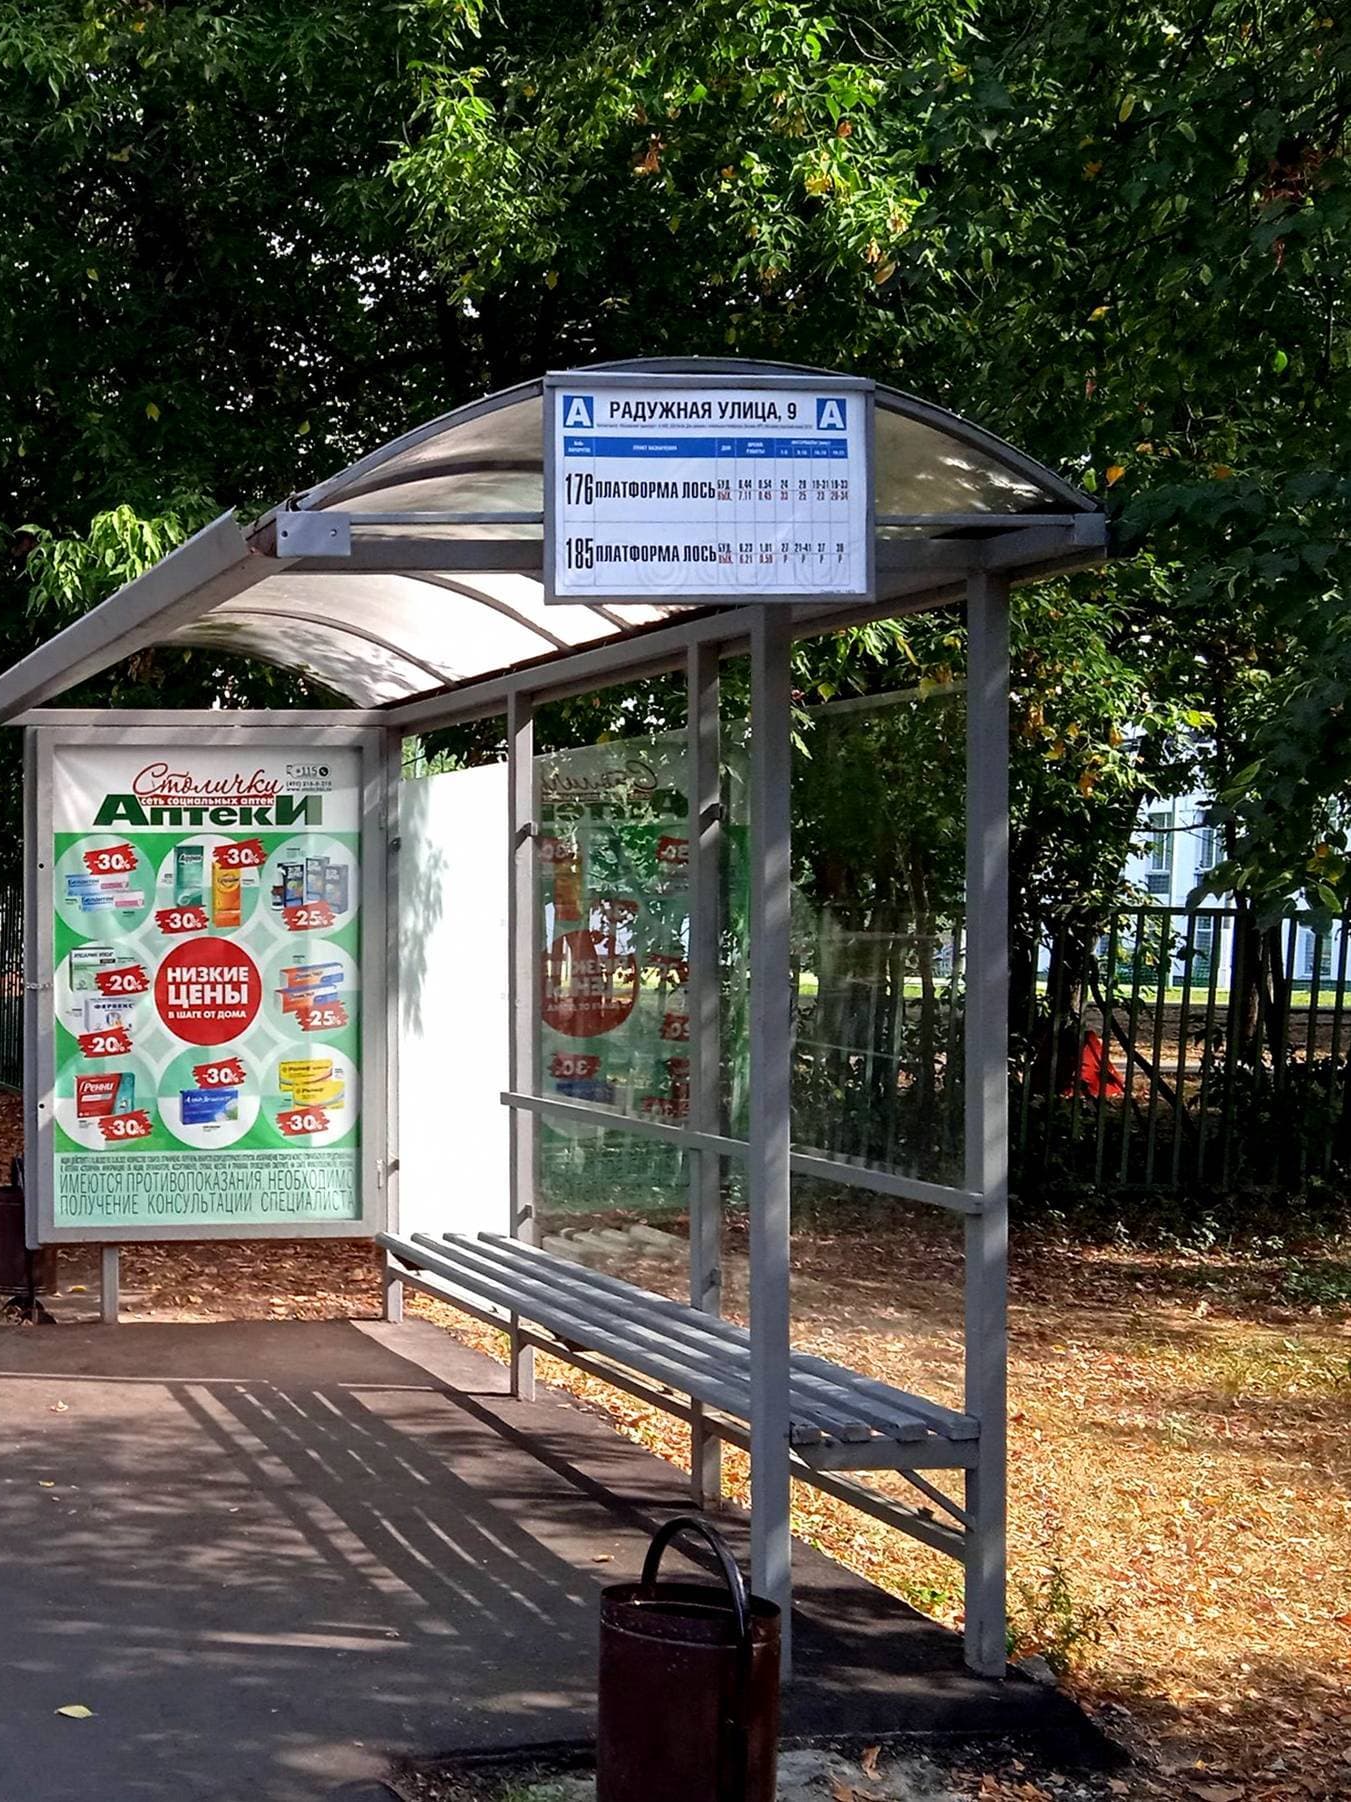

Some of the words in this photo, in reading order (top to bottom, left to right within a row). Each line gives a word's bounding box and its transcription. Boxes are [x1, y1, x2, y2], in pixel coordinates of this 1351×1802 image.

[609, 401, 712, 422] РАДУЖНАЯ
[719, 402, 782, 422] УЛИЦА,
[787, 402, 797, 420] 9
[565, 473, 593, 505] 176
[595, 480, 679, 499] ПЛАТФОРМА
[682, 481, 716, 499] ЛОСЬ
[566, 538, 594, 569] 185
[596, 545, 680, 563] ПЛАТФОРМА
[683, 545, 717, 563] ЛОСЬ
[132, 762, 283, 796] Столички
[141, 798, 165, 806] сеть
[167, 797, 238, 806] социальных
[240, 797, 275, 806] аптек
[93, 853, 131, 871] -30%
[223, 848, 260, 865] -30%
[165, 912, 202, 930] -30%
[105, 974, 143, 992] -20%
[167, 966, 249, 983] НИЗКИЕ
[168, 984, 249, 1009] ЦЕНЫ
[217, 1010, 247, 1019] ДОМА
[88, 1036, 125, 1053] -20%
[202, 1067, 240, 1084] -30%
[108, 1119, 146, 1136] -30%
[286, 1114, 324, 1131] -30%
[60, 1172, 123, 1194] ИМЕЮТСЯ
[60, 1194, 139, 1216] ПОЛУЧЕНИЕ
[147, 1192, 252, 1215] КОНСУЛЬТАЦИИ
